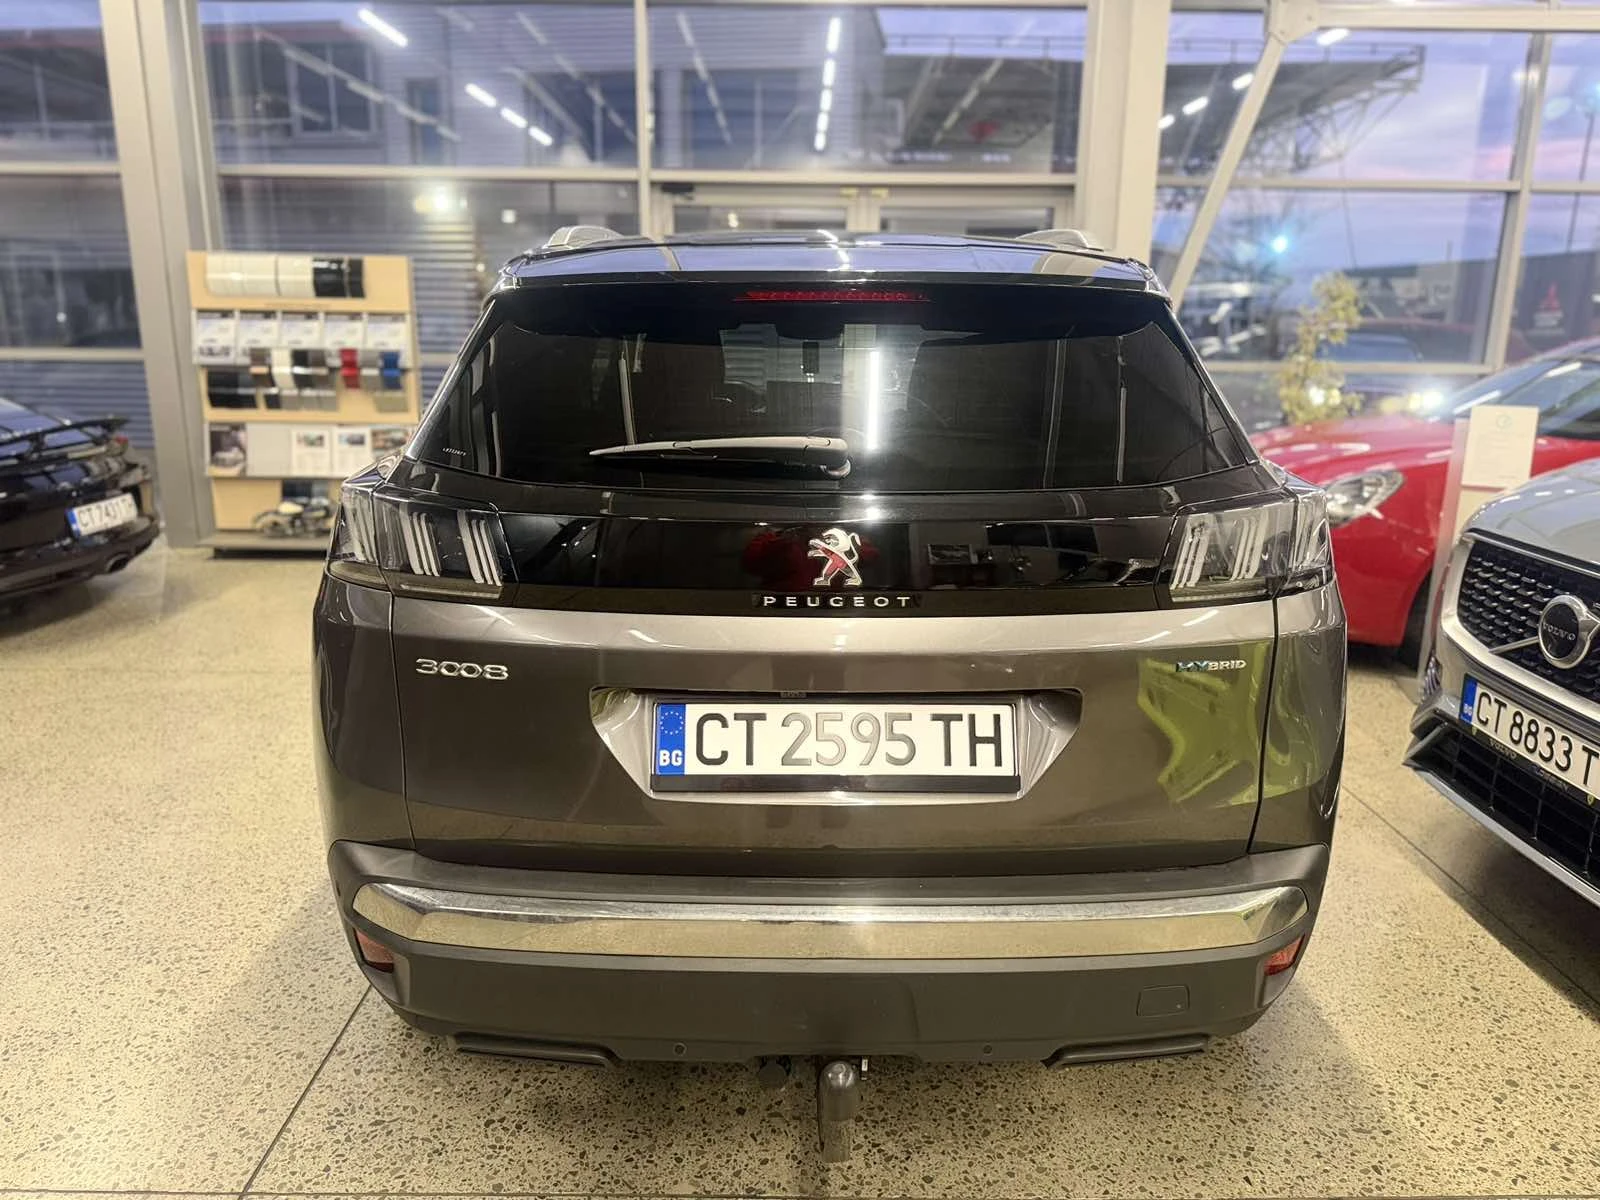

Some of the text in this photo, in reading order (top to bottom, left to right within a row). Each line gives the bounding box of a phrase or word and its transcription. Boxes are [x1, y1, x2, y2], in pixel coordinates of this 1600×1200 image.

[763, 596, 911, 607] PEUGEOT
[1543, 619, 1576, 641] VOLVO
[416, 658, 508, 680] 3008
[1176, 660, 1247, 672] HYBRID
[659, 711, 1003, 768] BG CT 2595 TH
[1476, 692, 1507, 734] CT
[1509, 710, 1573, 772] 8833
